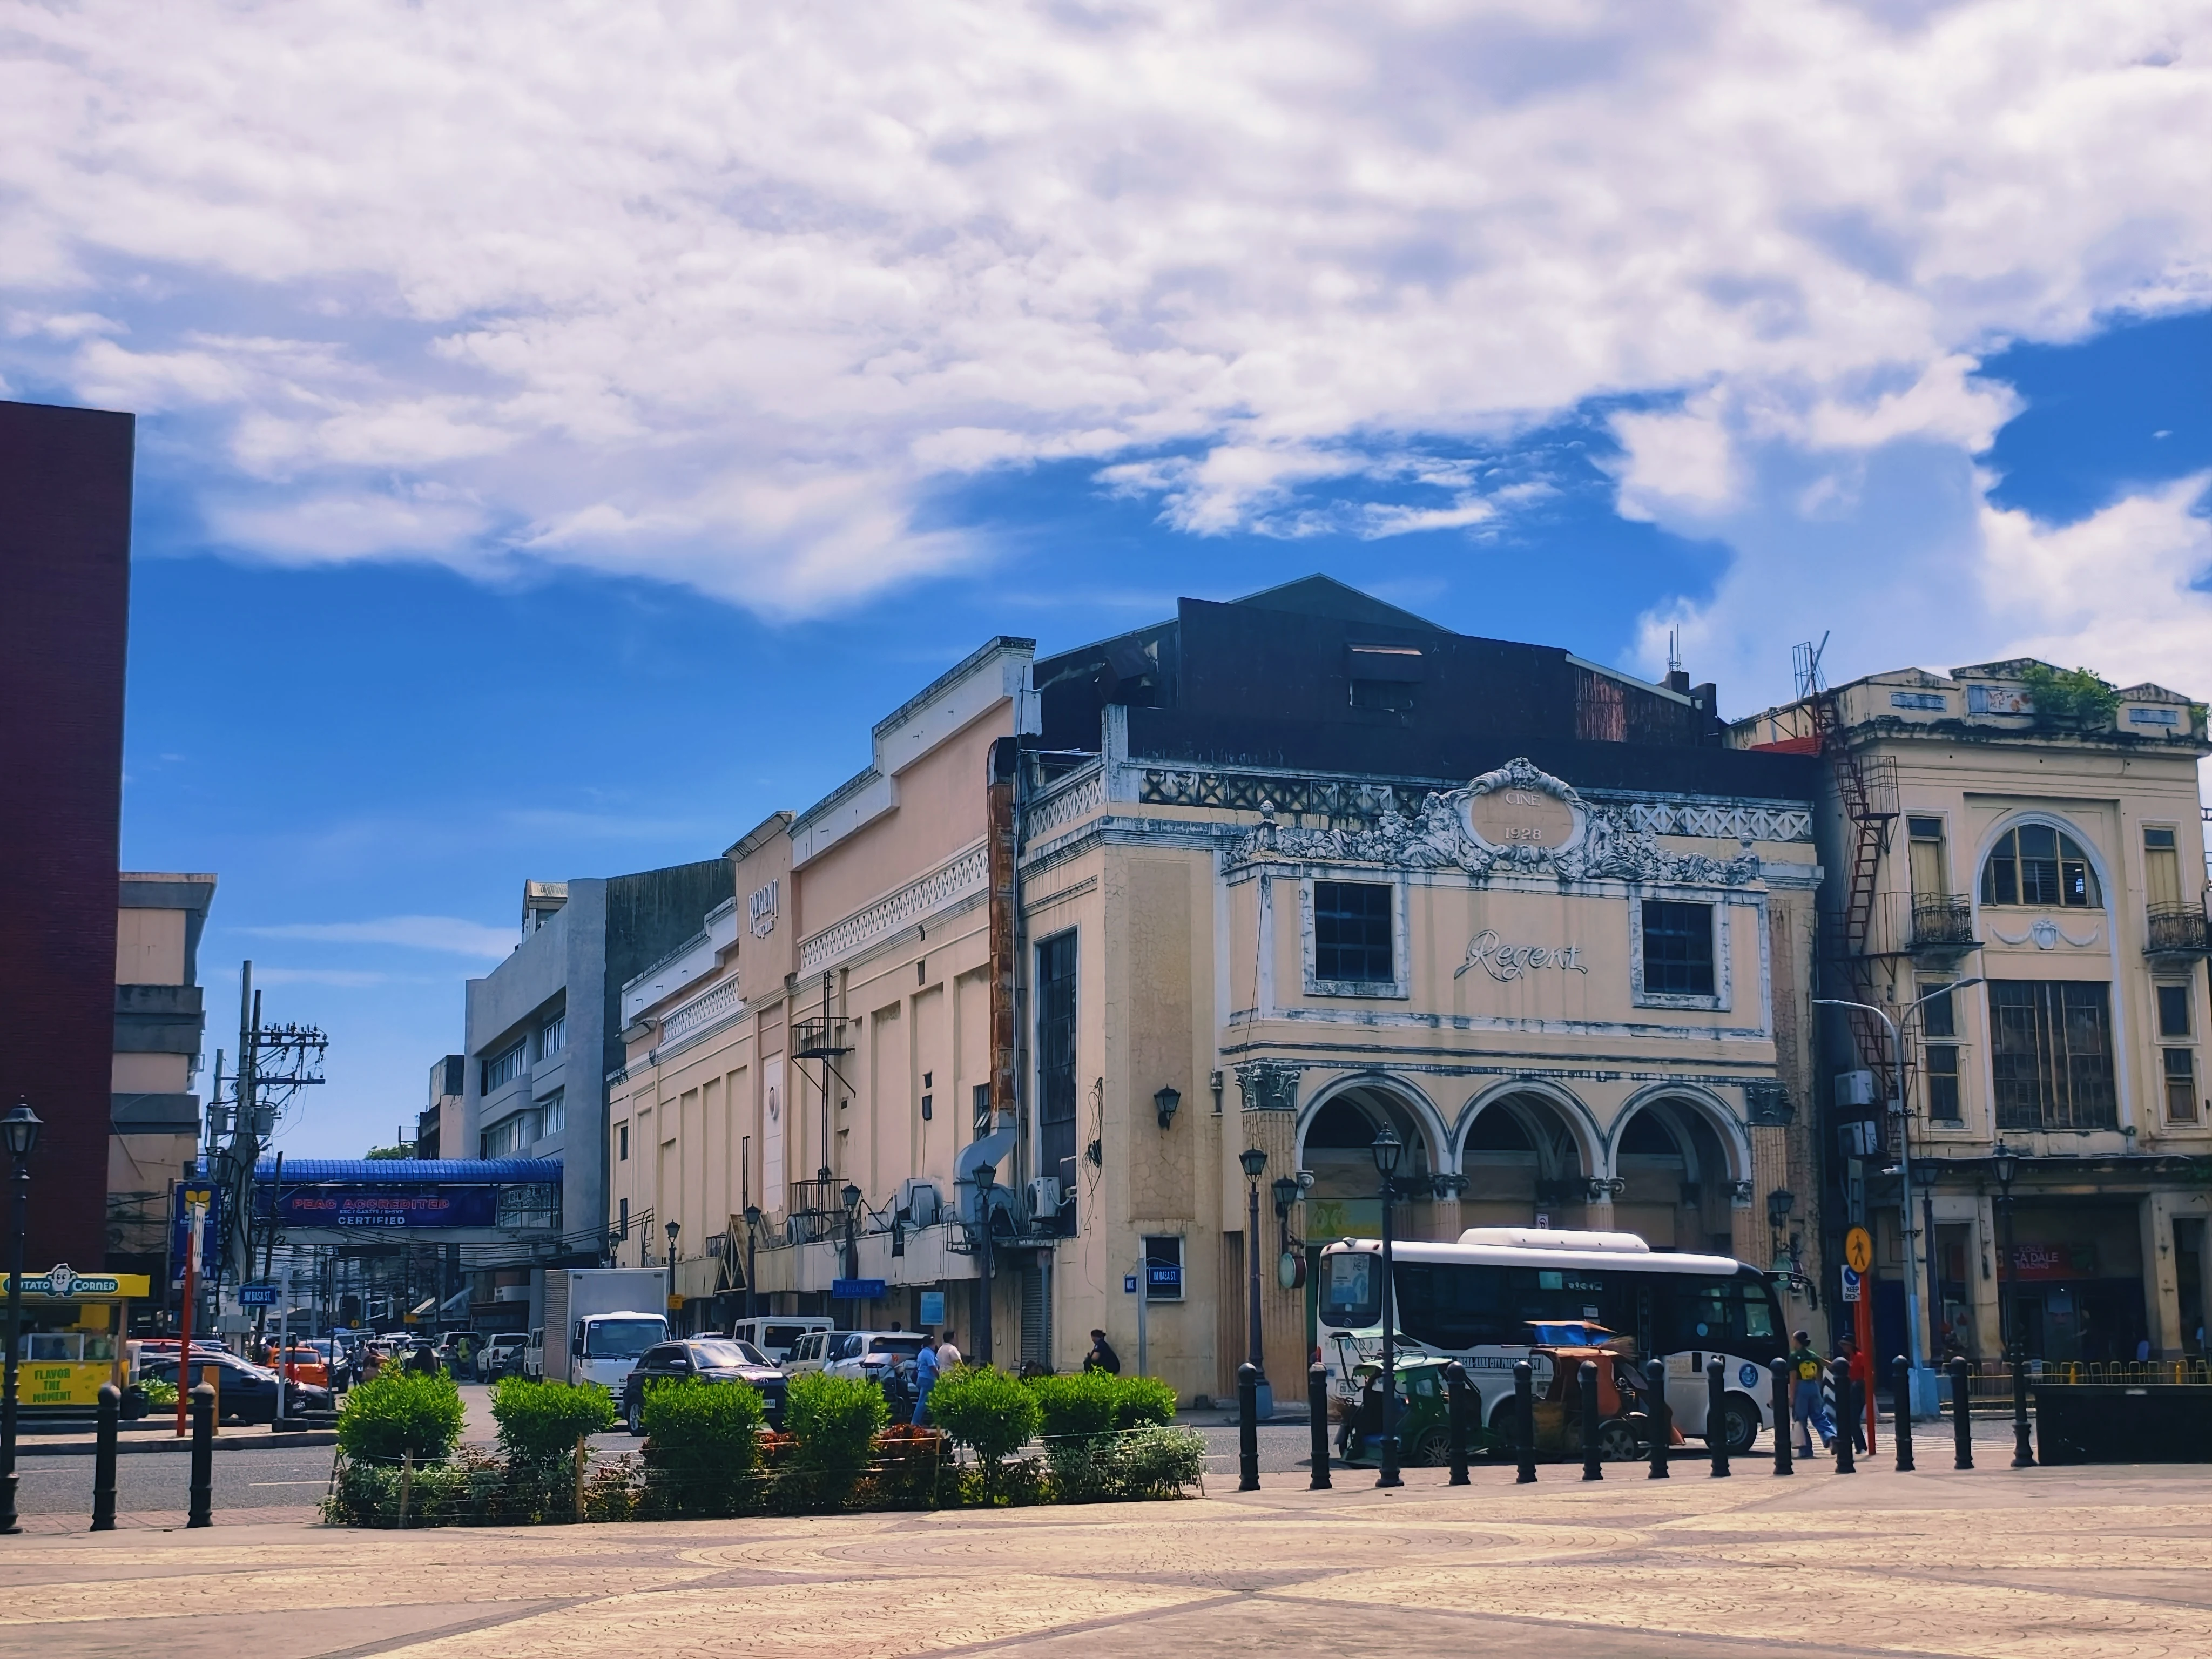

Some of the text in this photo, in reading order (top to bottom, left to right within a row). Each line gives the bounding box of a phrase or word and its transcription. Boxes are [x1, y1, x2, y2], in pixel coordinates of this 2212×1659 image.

[1505, 792, 1541, 807] CINE
[1505, 827, 1542, 840] 1928
[748, 878, 779, 934] REGENT
[1453, 929, 1588, 983] Regent
[342, 1199, 450, 1209] ACCREDITED
[338, 1216, 406, 1225] CERTIFIED
[2031, 1252, 2059, 1262] DALE
[179, 1266, 210, 1278] AM
[8, 1279, 50, 1291] TATO
[35, 1368, 70, 1380] FLAVOR
[44, 1380, 60, 1391] THE
[33, 1391, 71, 1402] MOMENT
